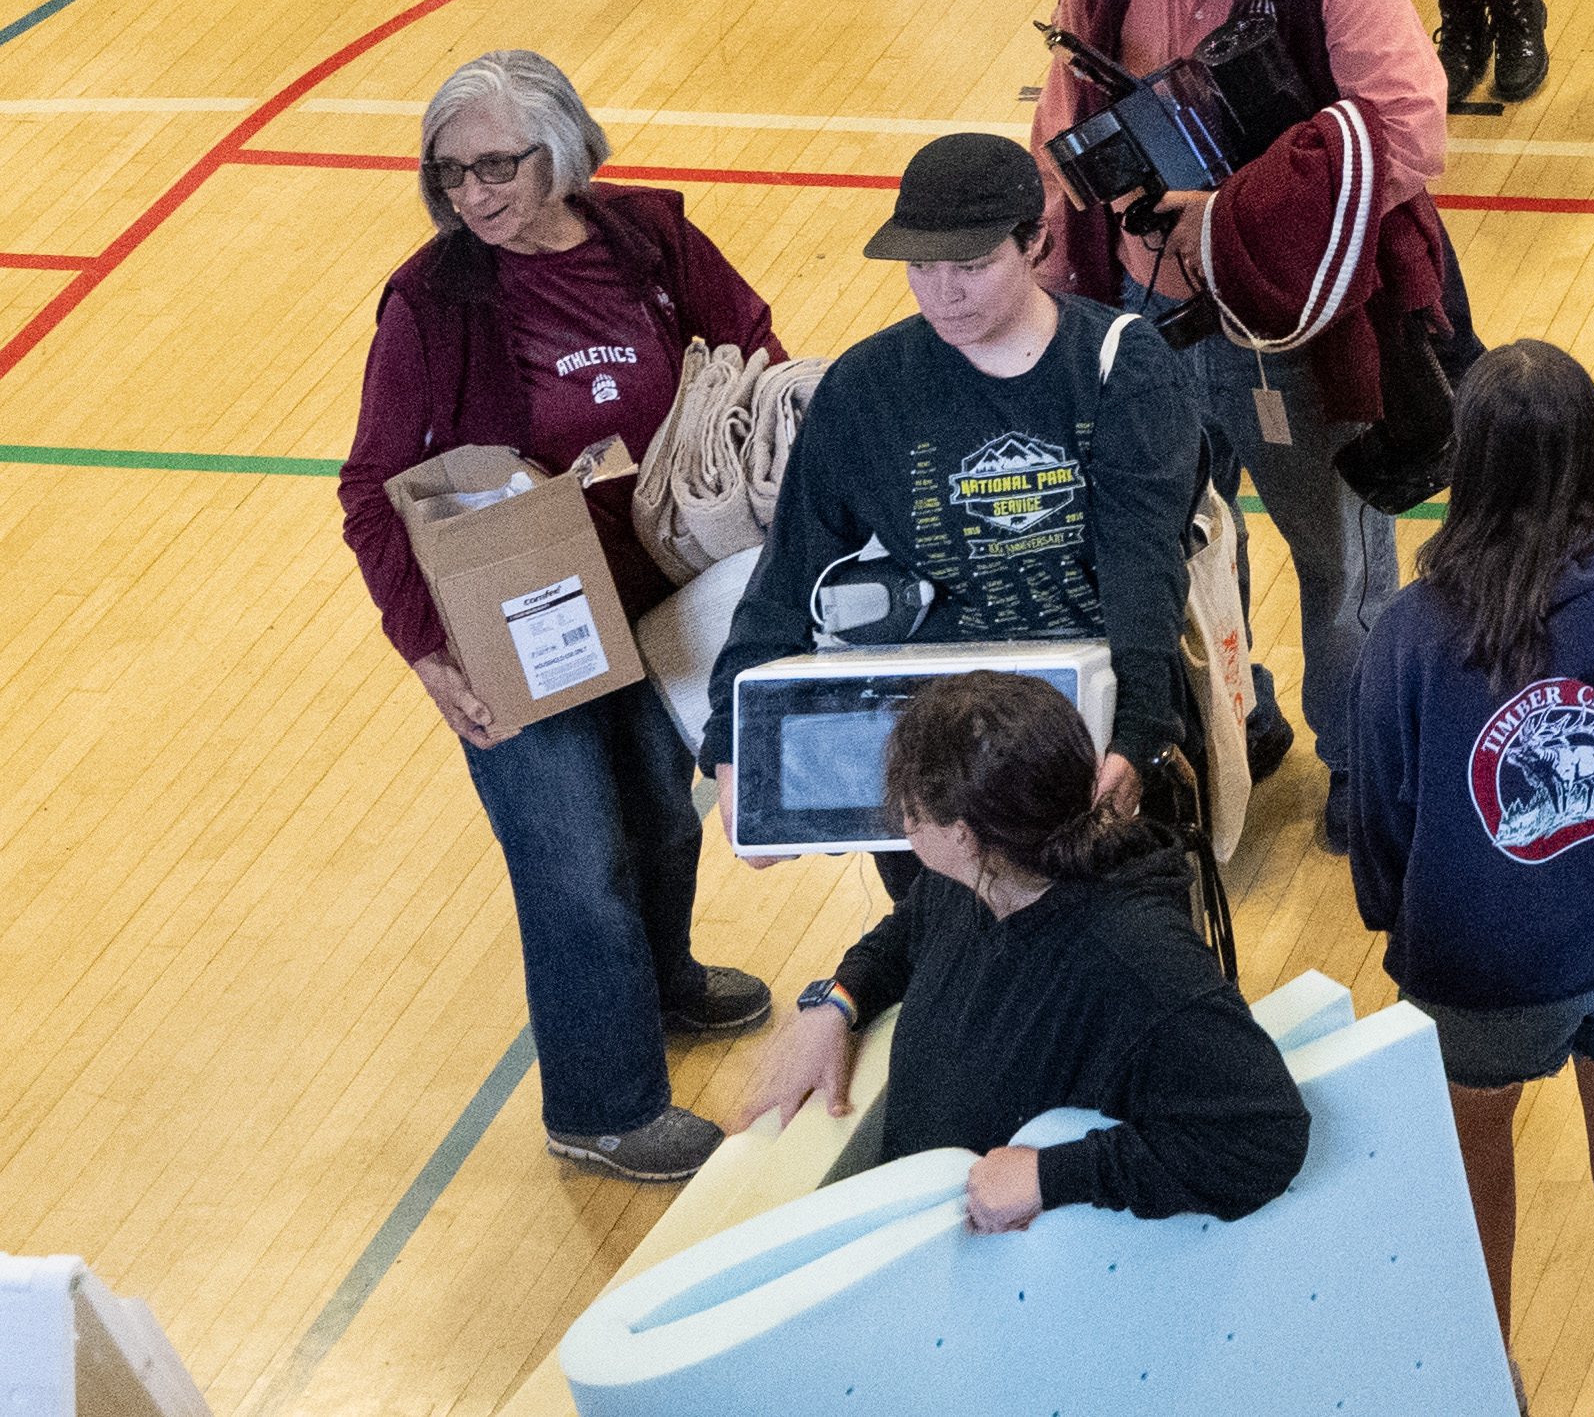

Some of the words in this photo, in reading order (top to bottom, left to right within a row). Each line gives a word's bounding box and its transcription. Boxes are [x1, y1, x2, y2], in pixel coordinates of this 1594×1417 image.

[556, 346, 638, 377] ATHLETICS
[961, 475, 1031, 496] NATIONAL
[1037, 468, 1073, 490] PARK
[993, 496, 1042, 517] SERVICE
[1483, 685, 1563, 757] TIMBER
